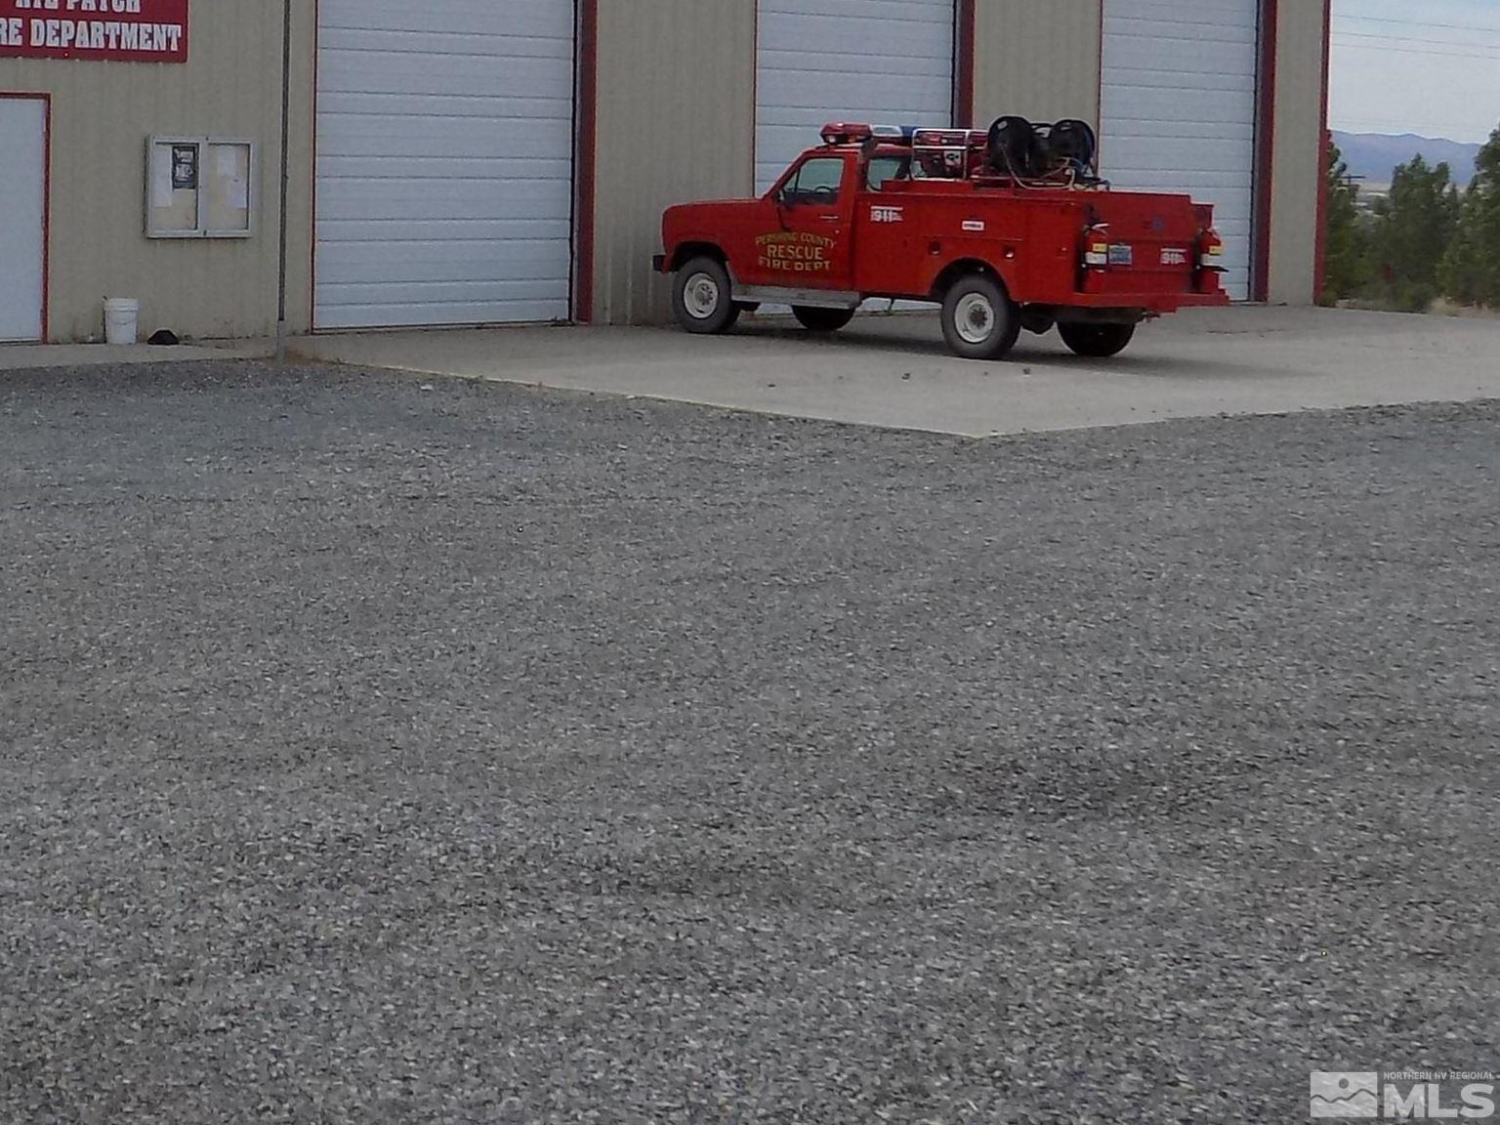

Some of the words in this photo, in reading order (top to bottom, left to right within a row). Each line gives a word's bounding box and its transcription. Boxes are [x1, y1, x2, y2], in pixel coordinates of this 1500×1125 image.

[30, 19, 182, 52] DEPARTMENT
[800, 232, 836, 248] COUNTY
[767, 244, 824, 260] RESCUE
[758, 255, 791, 271] FIRE
